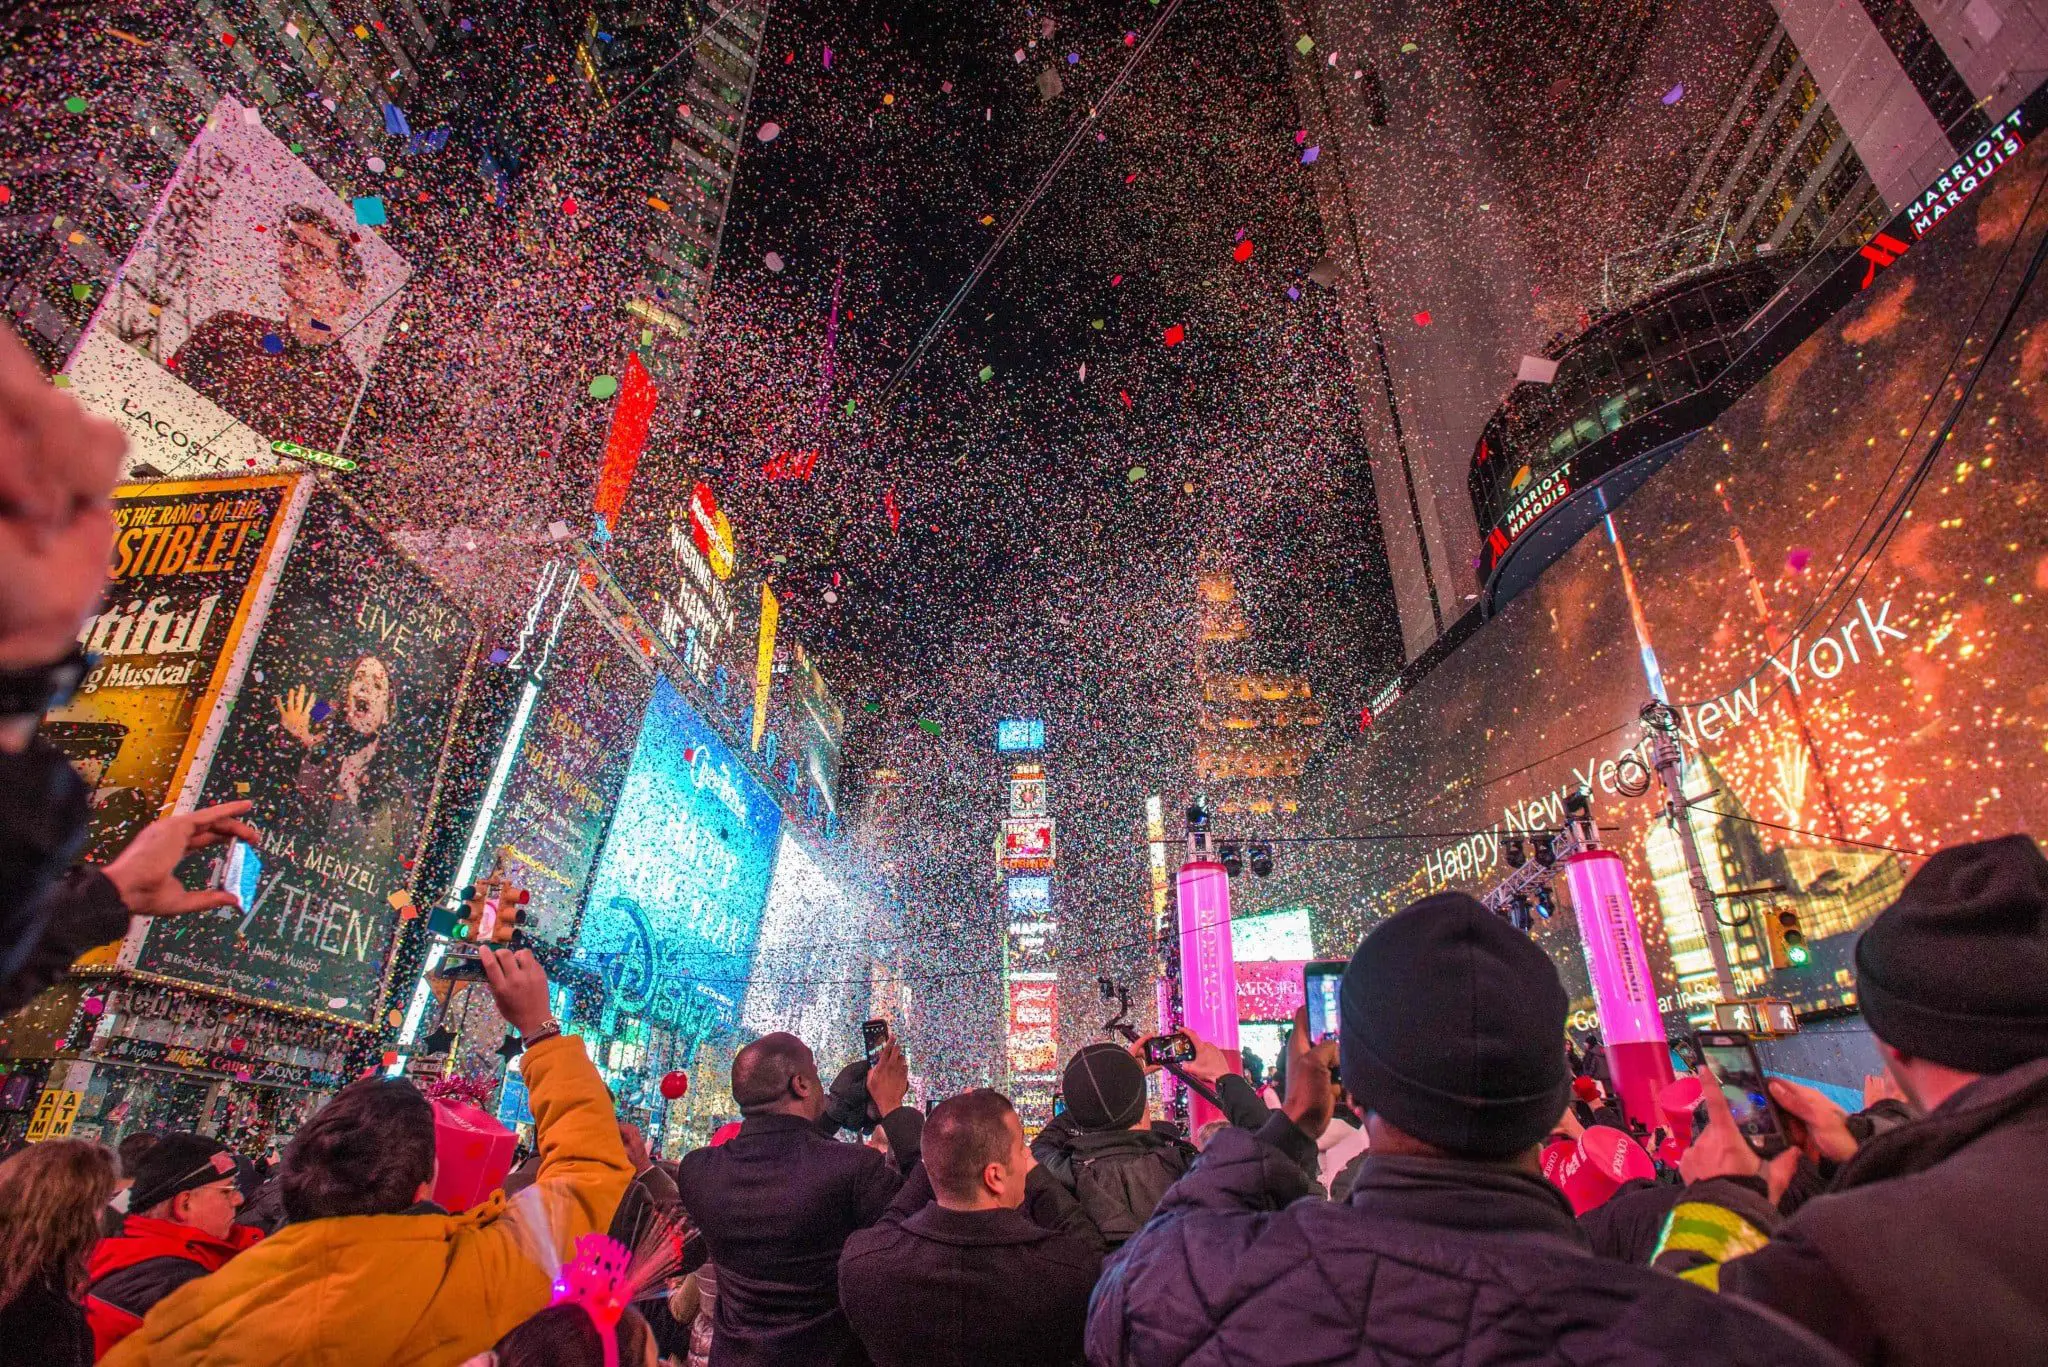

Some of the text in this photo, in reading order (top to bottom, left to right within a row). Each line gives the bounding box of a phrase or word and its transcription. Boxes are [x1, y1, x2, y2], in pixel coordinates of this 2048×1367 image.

[1907, 109, 2022, 220] MARRIOTT
[1915, 138, 2018, 233] MARQUIS
[121, 398, 229, 471] LACOSTE
[1506, 463, 1570, 523] MARRIOTT
[1510, 484, 1566, 537] MARQUIS
[131, 506, 162, 526] THE
[159, 505, 205, 525] RANKS
[357, 595, 412, 658] LIVE
[103, 660, 196, 691] Musical
[771, 662, 787, 674] LG
[1372, 676, 1402, 707] MARRIOTT
[1373, 689, 1400, 717] MARQUIS
[1425, 824, 1499, 887] Happy
[1504, 782, 1568, 838] New
[1765, 597, 1908, 695] York
[304, 847, 380, 896] MENZEL
[252, 942, 281, 961] New
[283, 951, 322, 974] Musical
[1675, 987, 1694, 1010] in
[128, 1046, 157, 1060] Apple
[210, 1056, 256, 1074] Canon
[260, 1064, 306, 1083] SONY
[32, 1093, 54, 1134] ATM
[53, 1094, 76, 1134] ATM
